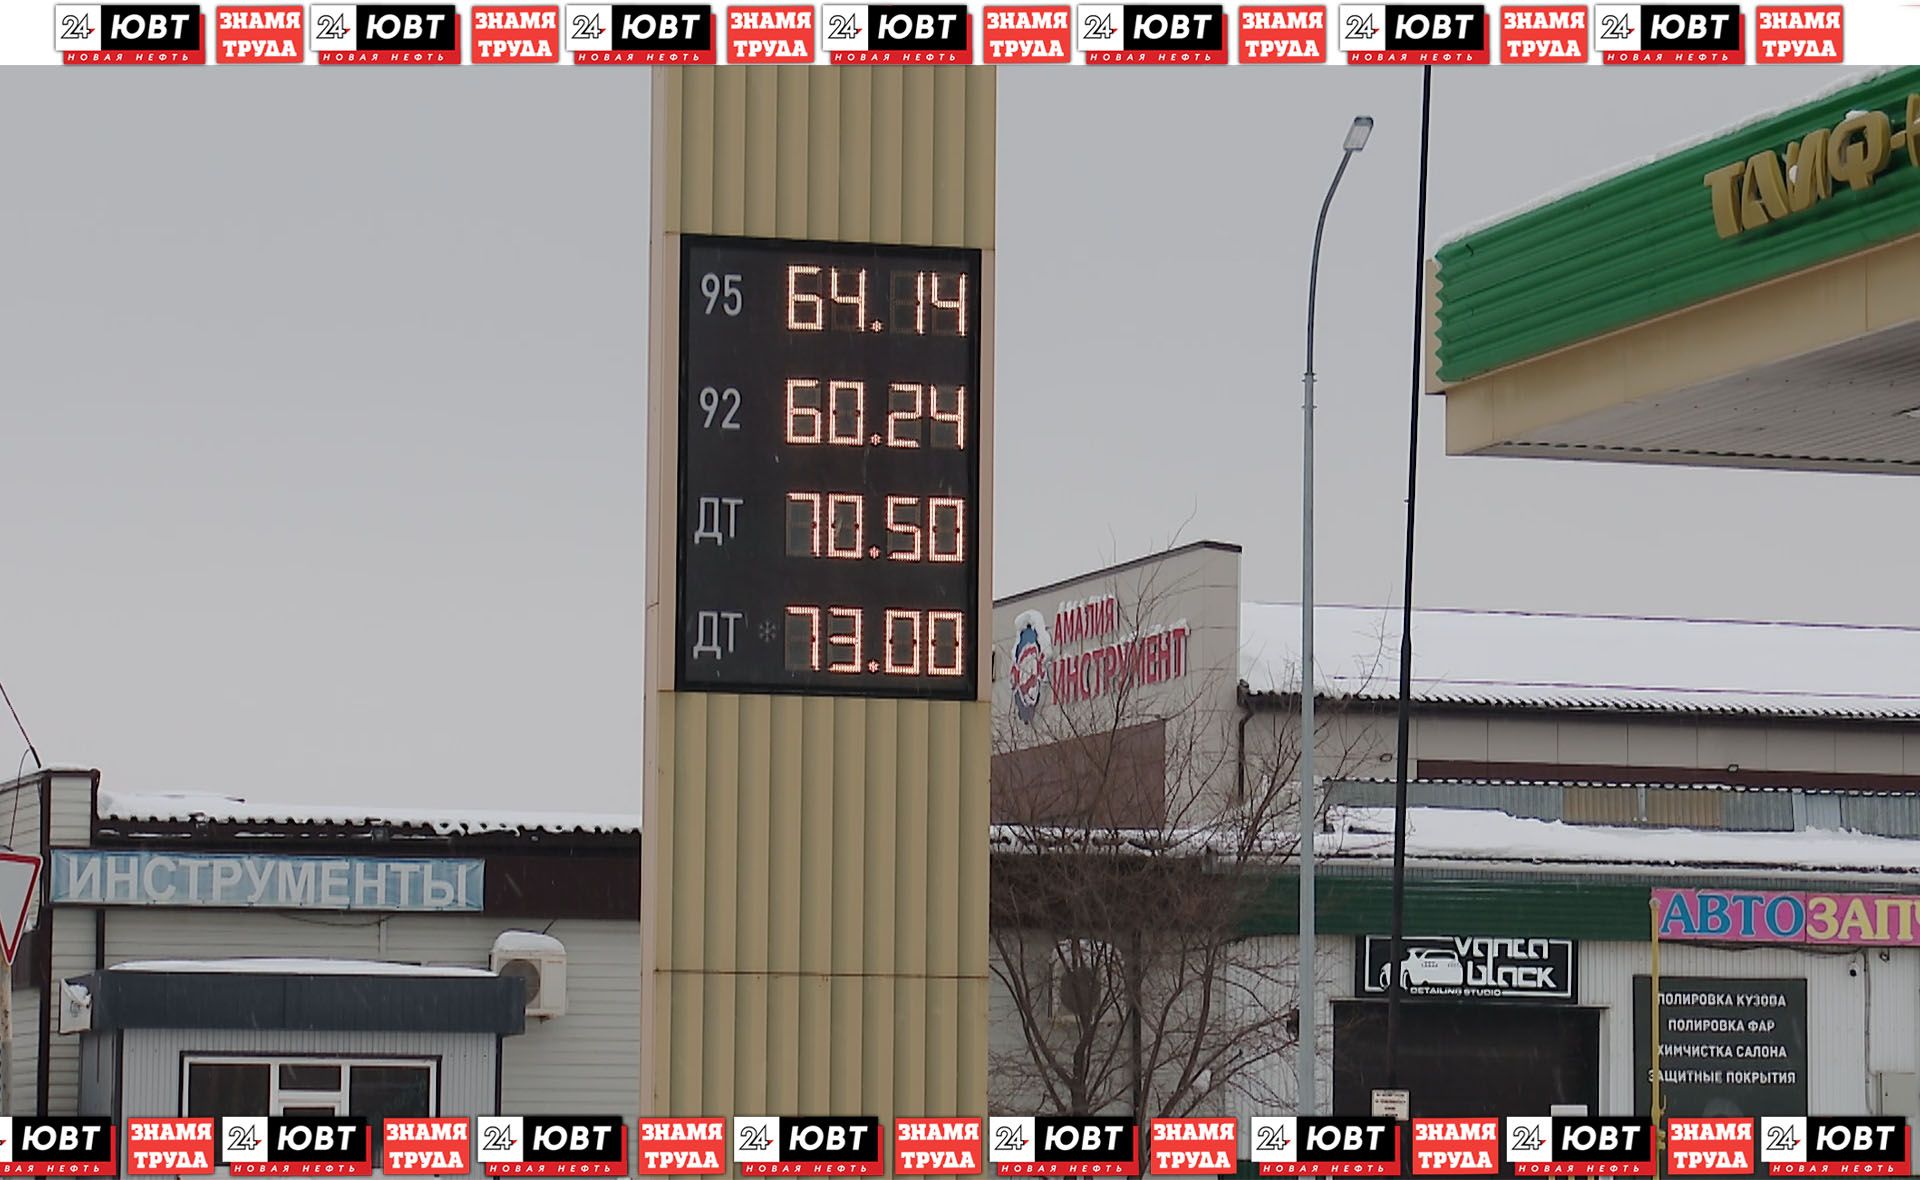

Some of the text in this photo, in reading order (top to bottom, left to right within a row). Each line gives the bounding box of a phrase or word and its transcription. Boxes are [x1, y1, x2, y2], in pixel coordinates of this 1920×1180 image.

[701, 265, 967, 336] 95 64.14
[700, 378, 965, 449] 92 60.24
[694, 493, 964, 562] ДТ 70.50
[693, 606, 963, 675] ДТ 73.00
[1054, 598, 1115, 646] АМАЛИЯ
[1052, 628, 1187, 705] ИНСТРУМЕНТ
[68, 856, 468, 906] ИНСТРУМЕНТЫ
[1660, 892, 1920, 940] АВТОЗАП
[1464, 989, 1502, 997] STUDIO
[1658, 993, 1733, 1005] ПОЛИРОВКА
[1668, 1019, 1775, 1032] ПОЛИРОВКА ФАР
[1658, 1045, 1787, 1058] ХИМЧИСТКА САЛОНА
[1726, 1072, 1796, 1084] ПОКРЫТИЯ
